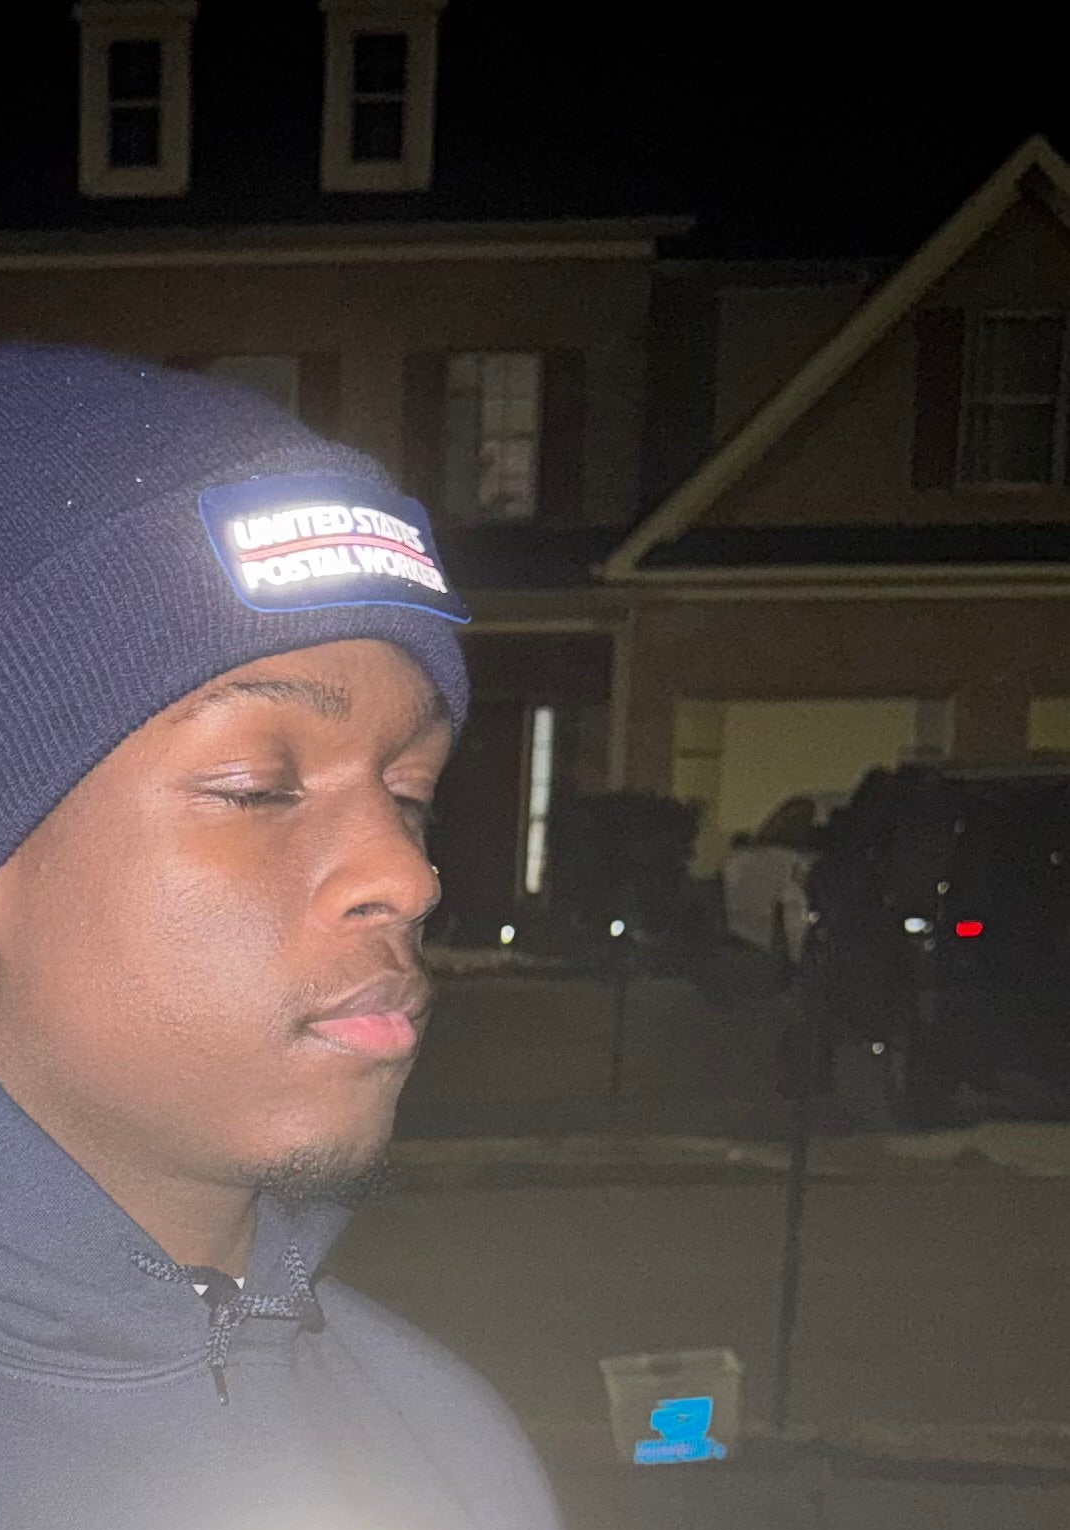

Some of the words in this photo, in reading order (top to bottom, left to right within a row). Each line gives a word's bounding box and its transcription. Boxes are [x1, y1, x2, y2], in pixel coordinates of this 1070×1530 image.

[233, 505, 354, 550] UNITED
[350, 506, 426, 553] STATES
[241, 545, 361, 589] POSTAL
[357, 545, 448, 593] WORKER
